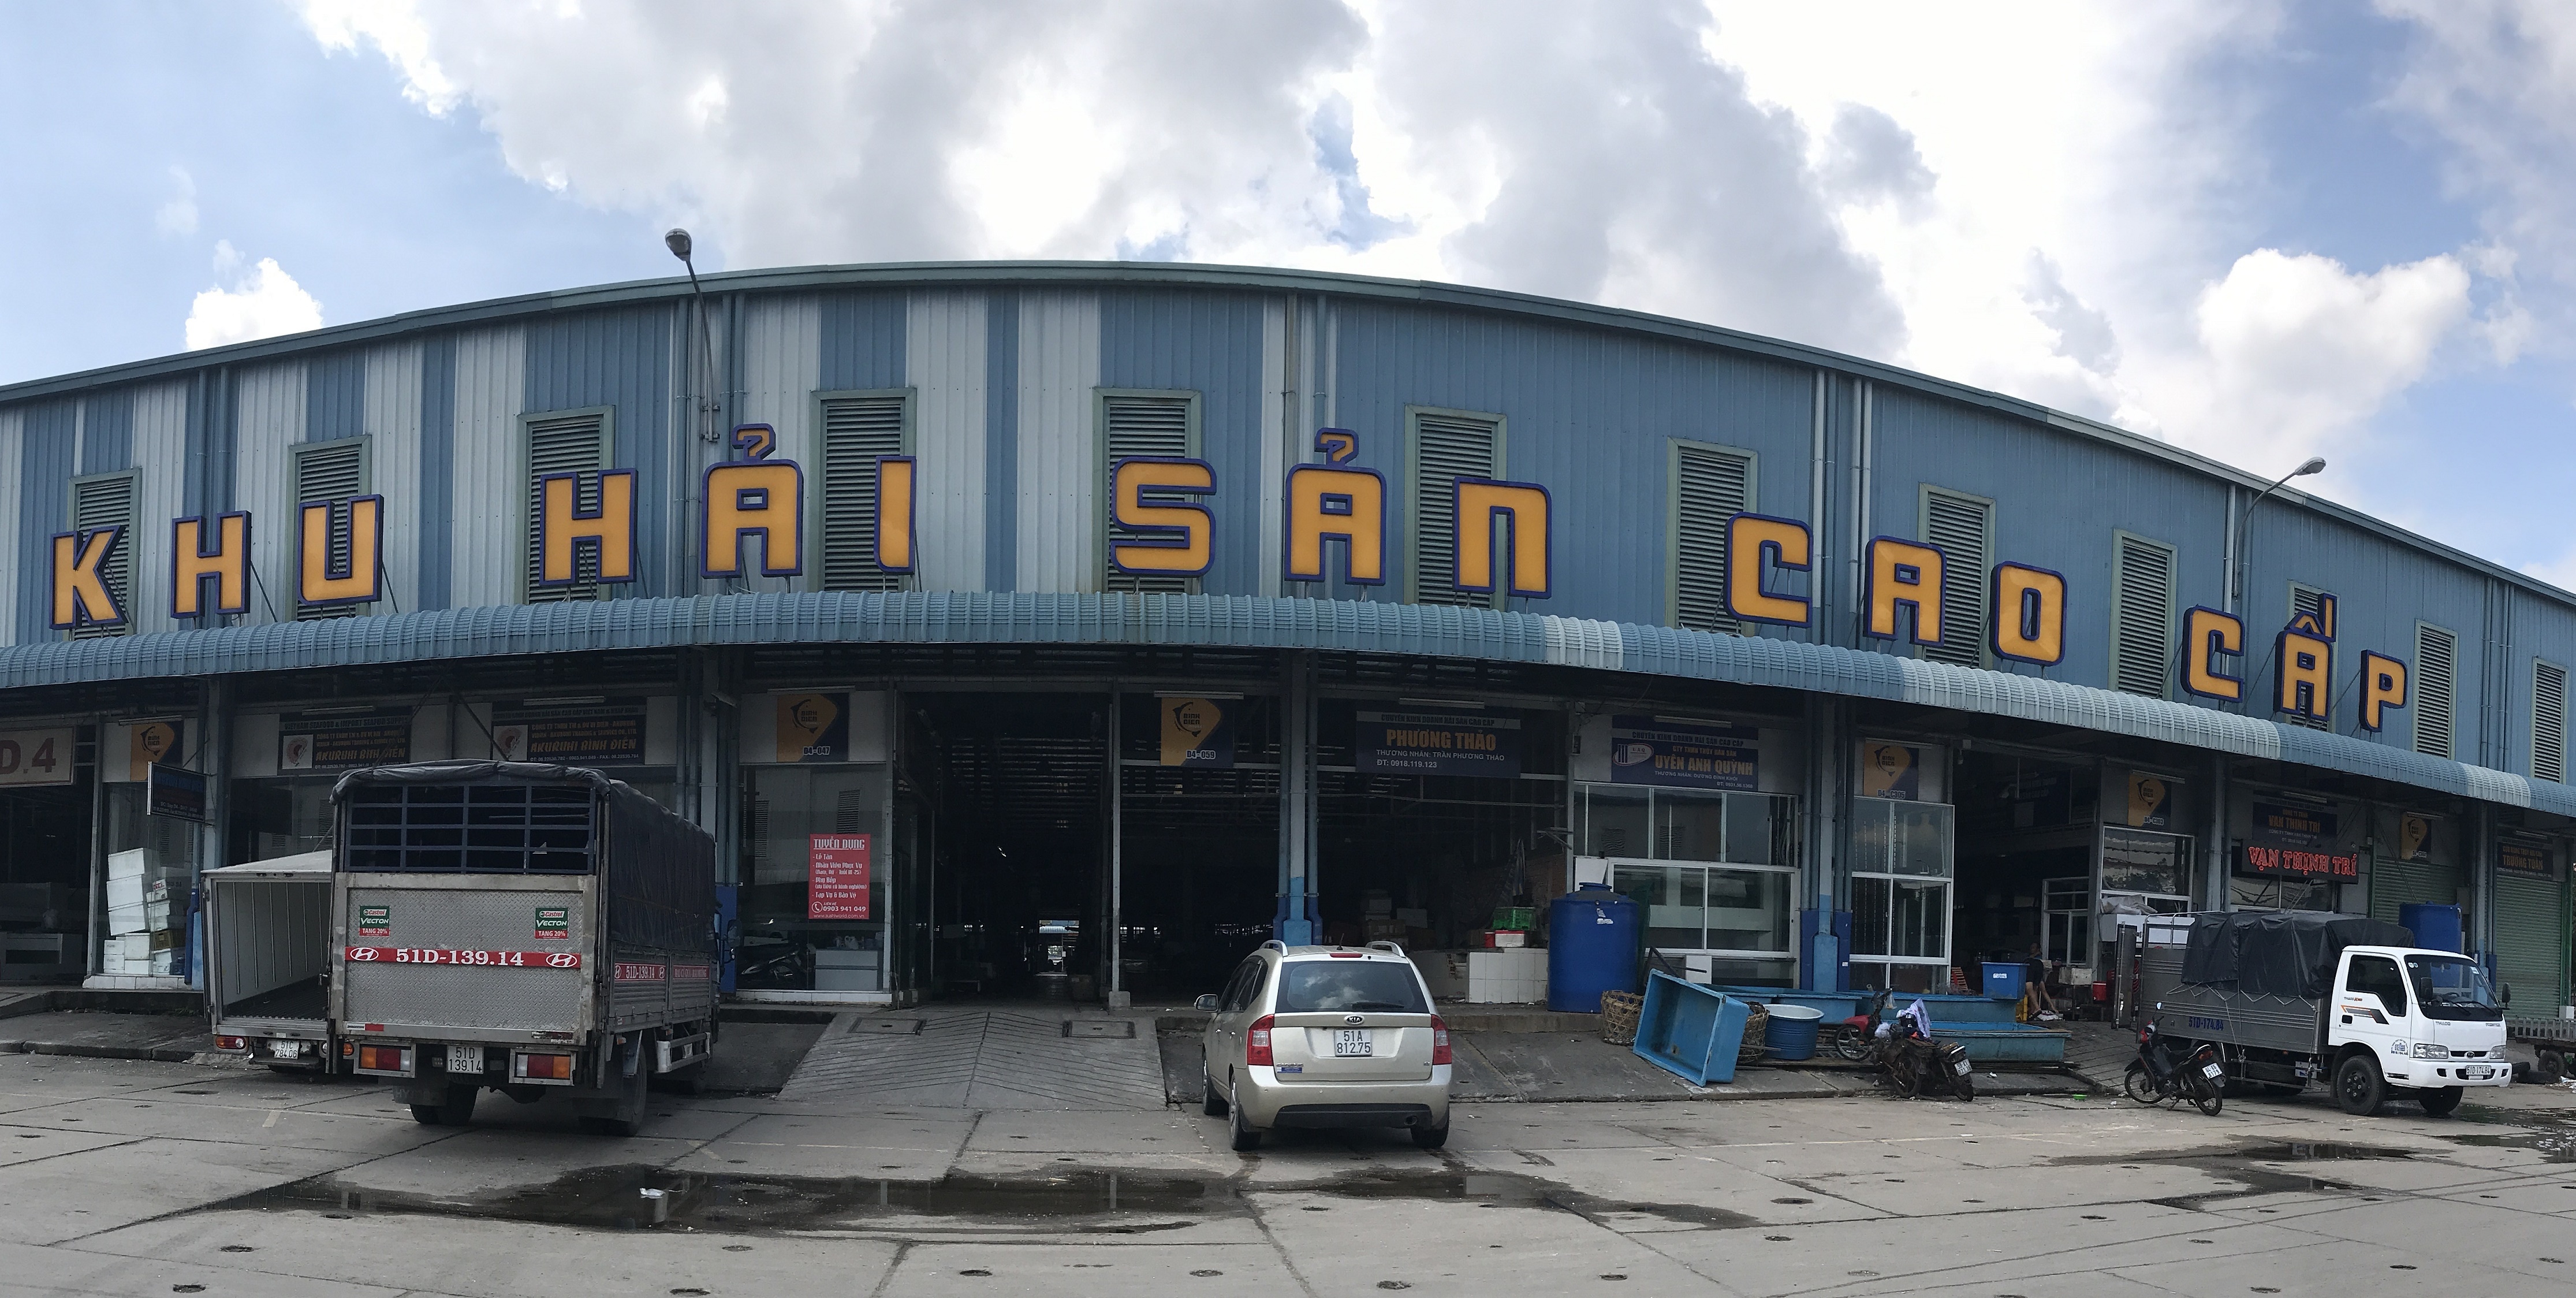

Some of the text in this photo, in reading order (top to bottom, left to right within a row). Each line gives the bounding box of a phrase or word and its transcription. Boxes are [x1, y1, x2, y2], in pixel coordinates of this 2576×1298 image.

[50, 423, 2407, 732] KHU HẢI SẢN CAO CẤP
[1386, 728, 1496, 751] PHƯƠNG THẢO
[530, 741, 578, 752] AKURUHI
[803, 746, 830, 756] D4-047
[1186, 750, 1216, 759] D4-059
[1453, 752, 1484, 760] PHƯƠNG
[1390, 760, 1437, 768] 0918.119.123
[1655, 754, 1753, 775] UYÊN ANH QUỲNH
[814, 836, 865, 850] TUYỂN DỤNG
[2248, 846, 2280, 871] VẠN
[2283, 850, 2330, 876] THỊNH
[536, 920, 568, 928] VECTON
[396, 948, 524, 966] 51D-139.14
[626, 965, 655, 979] 51D-139.14
[2189, 1017, 2224, 1031] 51D-174.84
[1343, 1031, 1363, 1042] 51A
[281, 1041, 293, 1049] 51C
[1336, 1043, 1371, 1054] 812.75
[456, 1047, 475, 1059] 51D
[449, 1059, 482, 1073] 139.14
